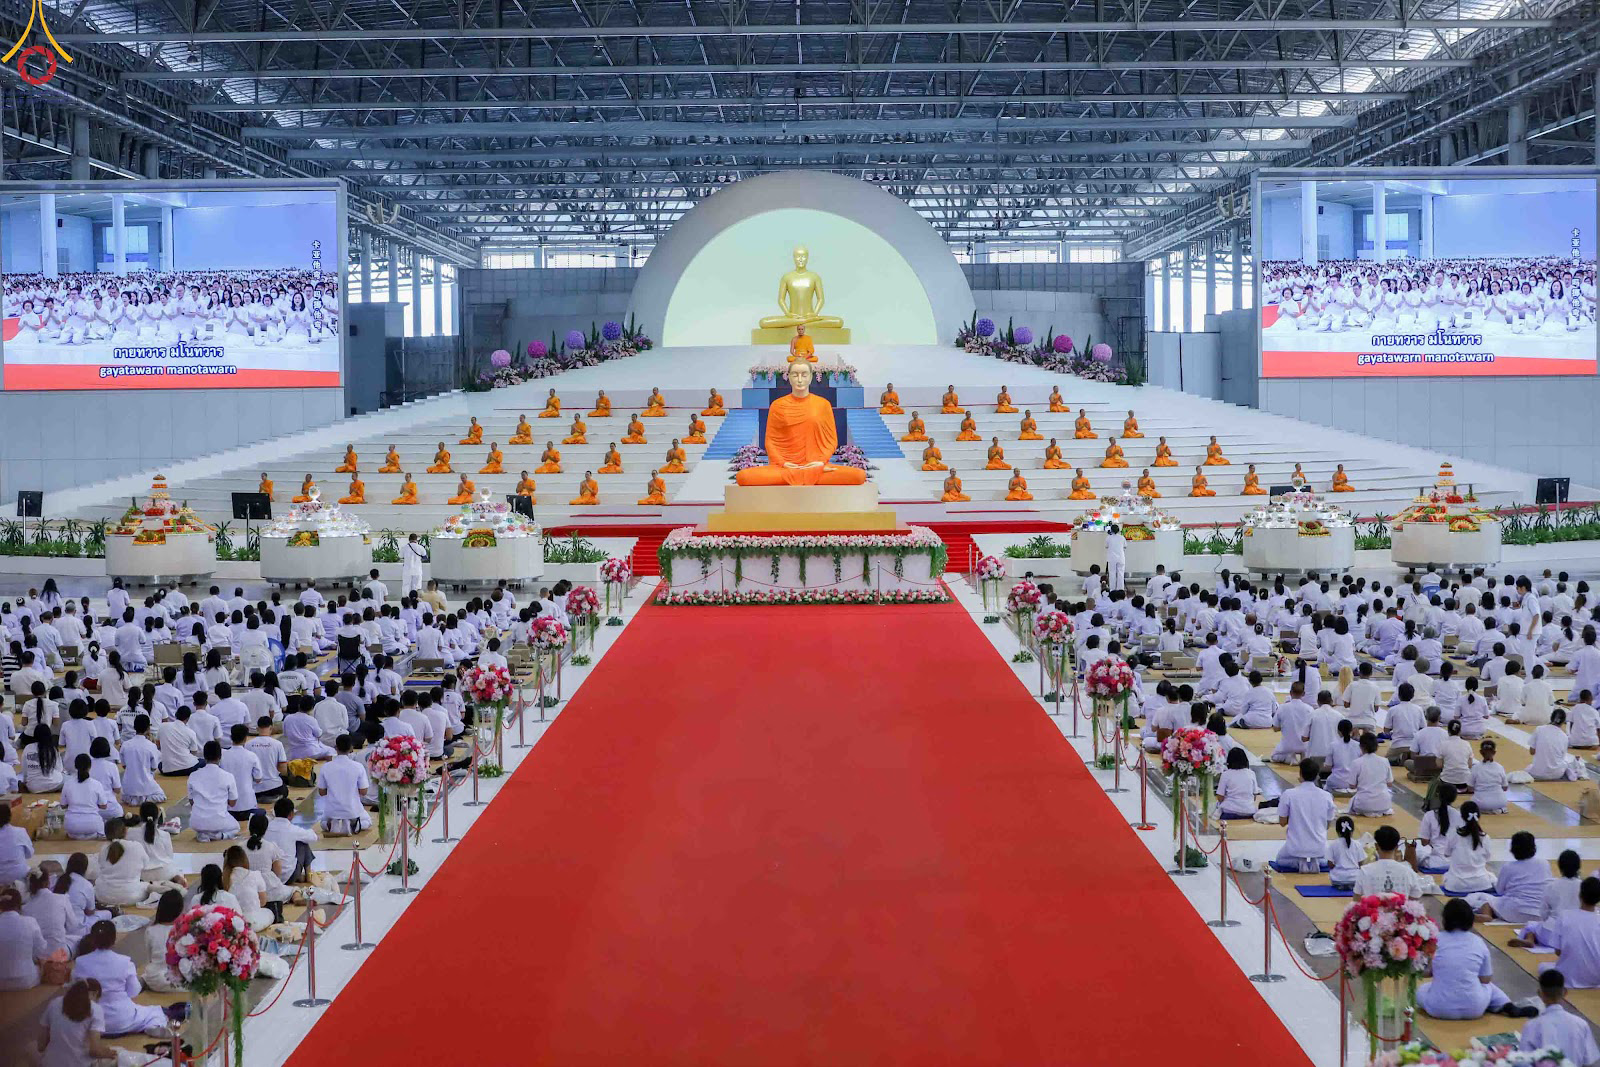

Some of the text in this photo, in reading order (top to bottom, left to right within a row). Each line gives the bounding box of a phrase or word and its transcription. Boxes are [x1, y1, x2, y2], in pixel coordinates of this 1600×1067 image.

[1372, 329, 1482, 346] กายทวาร มโนทวาร
[114, 341, 224, 358] กายทวาร มโนทวาร
[1358, 352, 1494, 365] gayatawarn manotawarn
[99, 364, 237, 378] gayatawarn manotawarn
